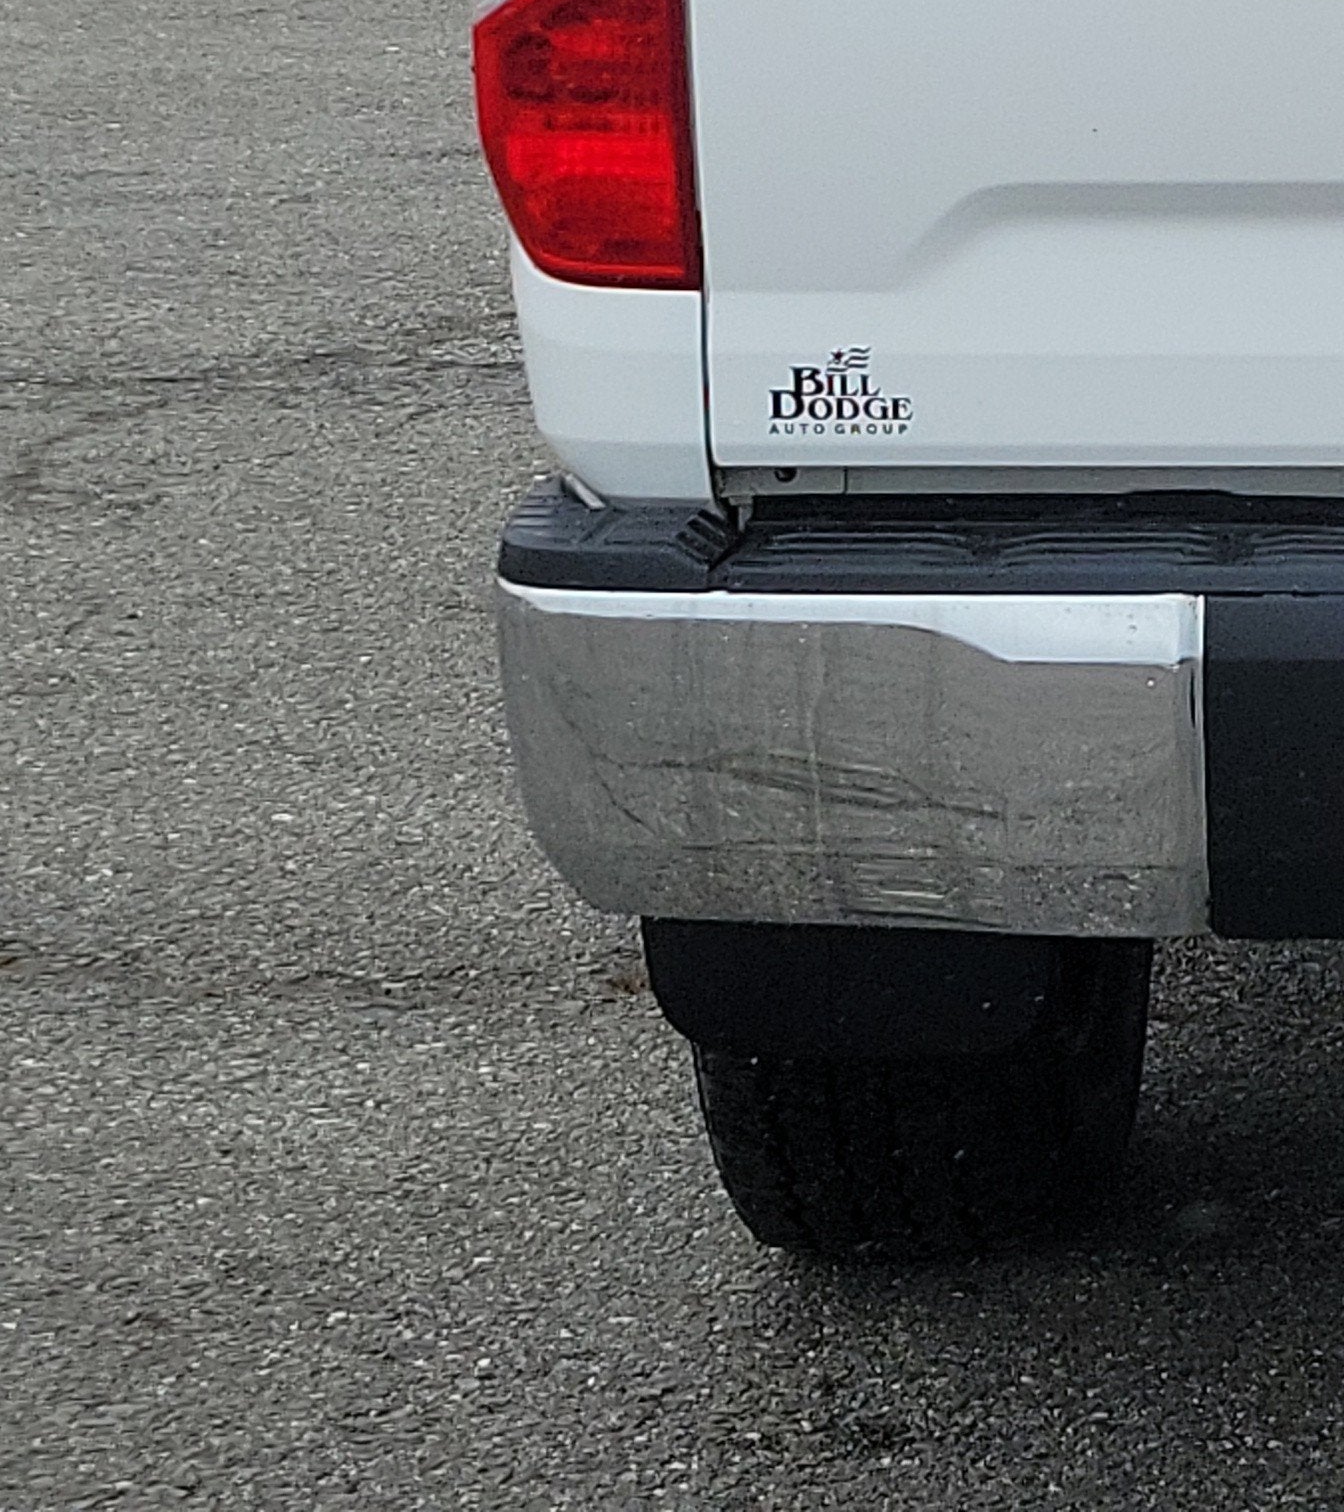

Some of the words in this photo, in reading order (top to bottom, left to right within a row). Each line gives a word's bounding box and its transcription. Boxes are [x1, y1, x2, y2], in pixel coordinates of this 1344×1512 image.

[790, 365, 881, 397] BILL
[768, 388, 914, 421] DODGE
[768, 422, 826, 436] AUTO
[834, 422, 909, 436] GROUP
